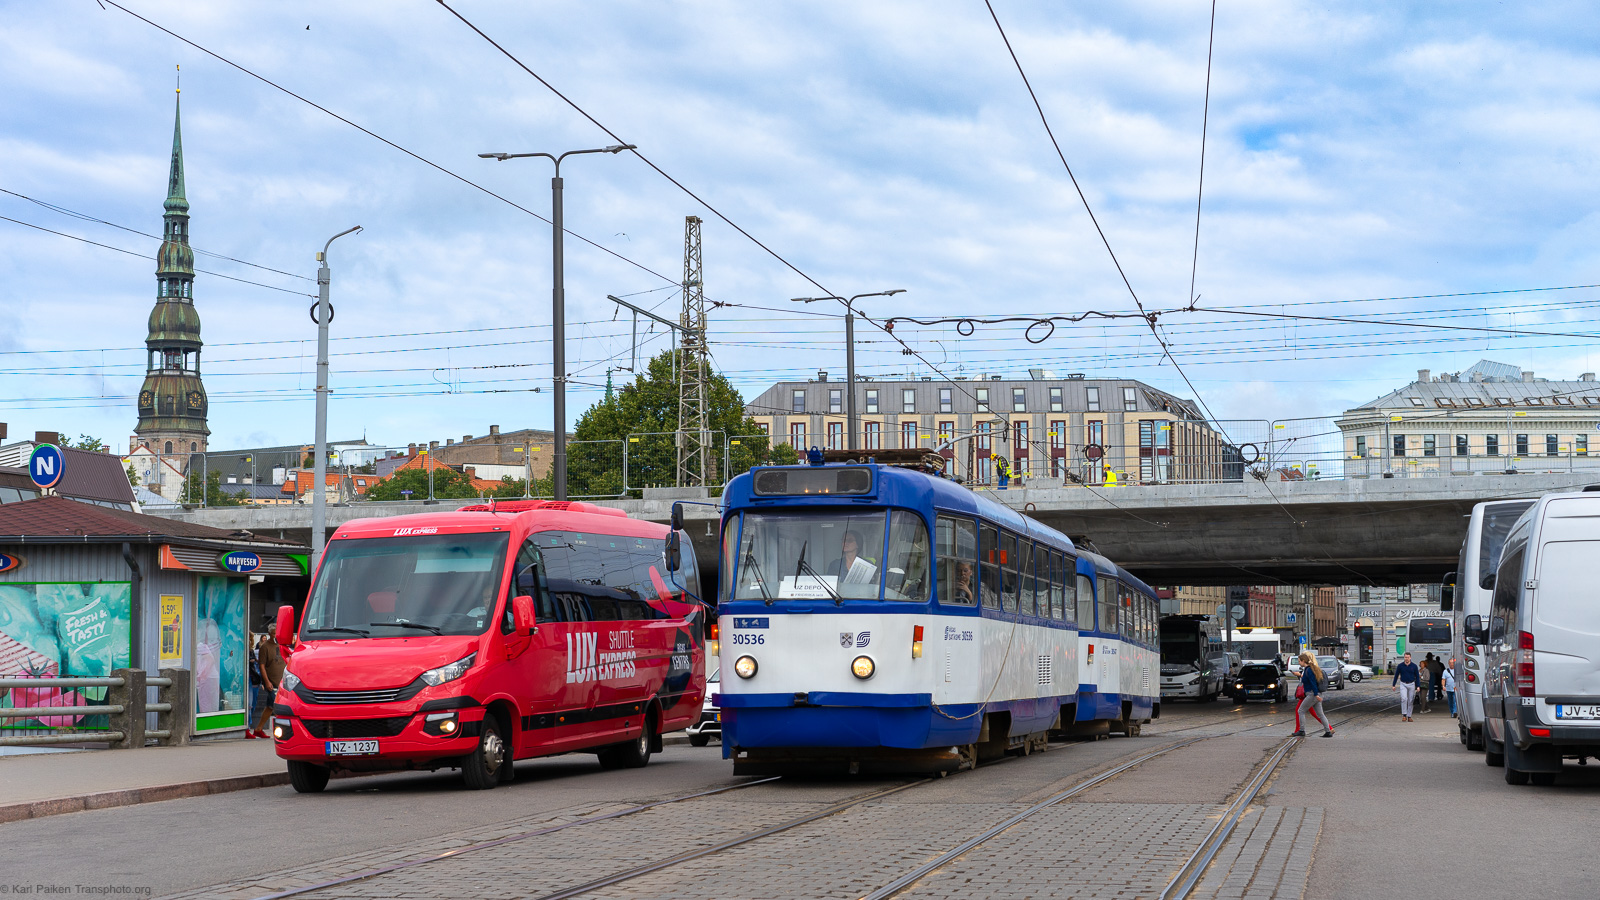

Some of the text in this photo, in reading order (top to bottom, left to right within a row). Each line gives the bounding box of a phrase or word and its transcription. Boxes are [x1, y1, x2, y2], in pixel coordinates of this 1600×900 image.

[36, 456, 54, 475] N
[393, 528, 413, 536] LUX
[228, 556, 257, 566] NARVESEN
[65, 609, 108, 632] FRESH &
[67, 620, 106, 645] TASTY
[608, 630, 635, 650] SHUTTLE
[732, 633, 765, 645] 30536
[566, 632, 637, 684] LUX EXPRESS
